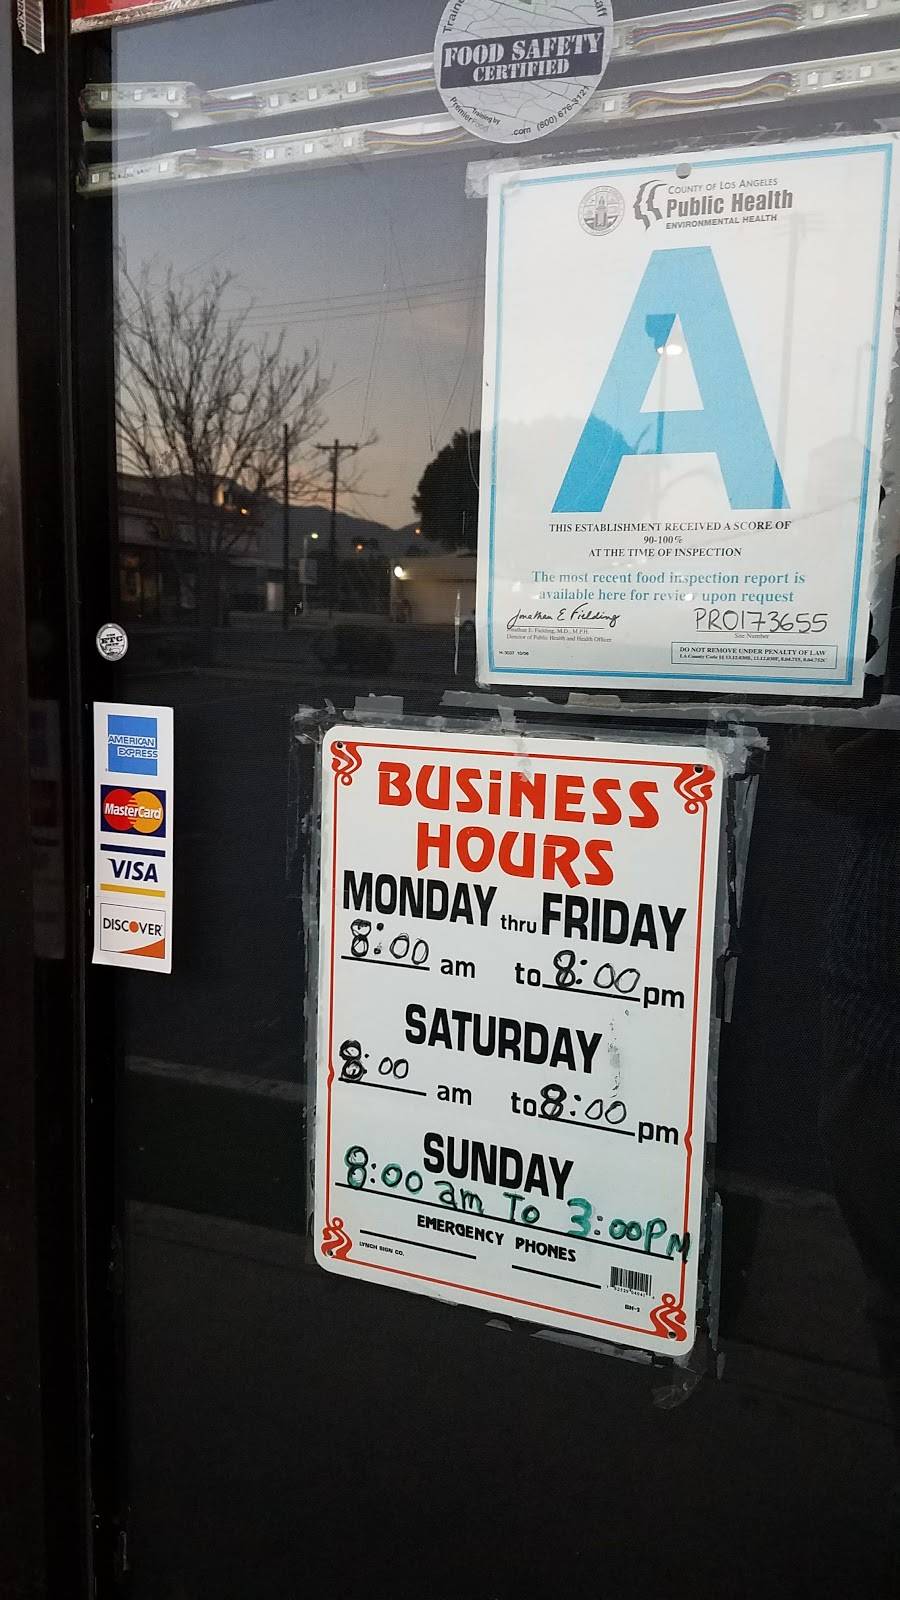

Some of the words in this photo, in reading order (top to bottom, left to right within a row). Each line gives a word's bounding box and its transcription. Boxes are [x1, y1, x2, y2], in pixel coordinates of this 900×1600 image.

[443, 43, 505, 68] FOOD
[511, 32, 605, 61] SAFETY
[473, 58, 570, 82] CERTIFIED
[668, 185, 703, 195] COUNTY
[719, 181, 736, 190] LOS
[739, 178, 778, 188] ANGELES
[666, 195, 725, 218] Public
[731, 189, 793, 213] Health
[665, 217, 740, 230] ENVIRONMENTAL
[742, 213, 778, 224] HEALTH
[551, 246, 791, 513] A
[549, 523, 572, 533] THIS
[574, 522, 662, 533] ESTABLISHMENT
[664, 521, 721, 532] RECEIVED
[723, 521, 731, 531] A
[733, 521, 773, 531] SCORE
[775, 520, 792, 530] OF
[643, 535, 683, 545] 90-100%
[588, 548, 602, 558] AT
[603, 548, 625, 558] THE
[626, 548, 656, 558] TIME
[657, 548, 673, 557] OF
[674, 547, 743, 557] INSPECTION
[531, 571, 555, 583] The
[559, 571, 588, 583] most
[592, 571, 632, 584] recent
[635, 571, 665, 584] food
[669, 571, 739, 587] inspection
[744, 571, 789, 587] report
[794, 571, 806, 584] is
[539, 588, 595, 601] available
[598, 588, 626, 601] here
[630, 589, 650, 601] for
[702, 590, 737, 605] upon
[741, 590, 794, 606] request
[764, 648, 797, 656] PENALTY
[108, 735, 156, 748] AMERICAN
[117, 747, 158, 758] EXPRESS
[104, 802, 162, 820] MasterCard
[416, 822, 614, 889] HOURS
[108, 859, 159, 883] VISA
[343, 870, 498, 927] MONDAY
[500, 914, 538, 934] thru
[541, 891, 687, 952] FRIDAY
[103, 917, 162, 937] DISCOVER
[350, 918, 430, 965] 8:00
[440, 958, 476, 979] am
[515, 963, 541, 987] to
[553, 949, 641, 994] 8:00
[643, 985, 685, 1009] pm
[405, 1003, 603, 1074] SATURDAY
[339, 1039, 409, 1081] 8:00
[437, 1084, 472, 1106] am
[511, 1091, 537, 1117] to
[540, 1083, 627, 1125] 8:00
[638, 1120, 679, 1145] pm
[423, 1132, 575, 1200] SUNDAY
[345, 1145, 423, 1194] 8:00
[434, 1180, 484, 1215] am
[502, 1191, 540, 1224] To
[417, 1214, 505, 1245] EMERGENCY
[515, 1236, 577, 1262] PHONES
